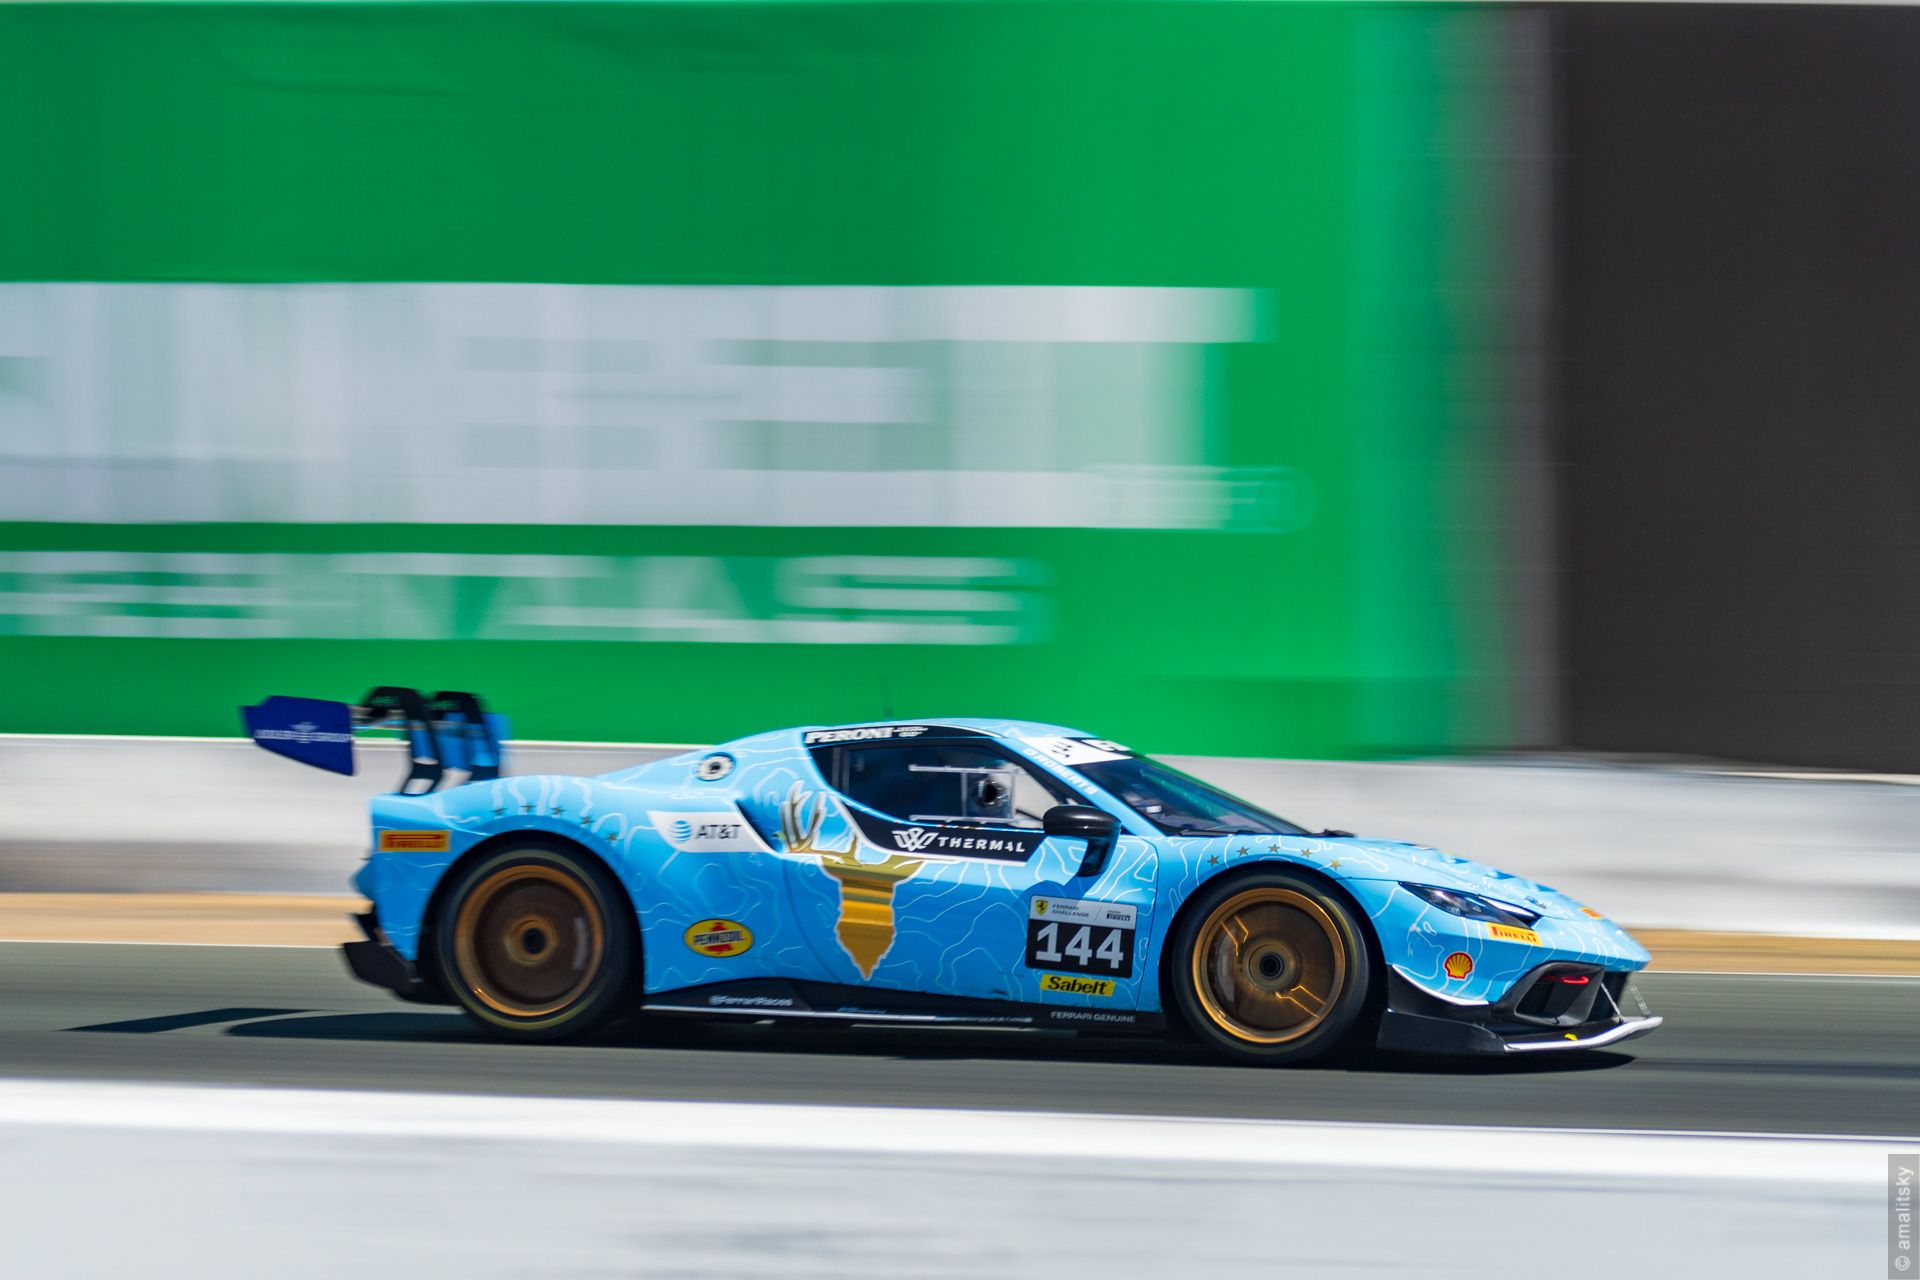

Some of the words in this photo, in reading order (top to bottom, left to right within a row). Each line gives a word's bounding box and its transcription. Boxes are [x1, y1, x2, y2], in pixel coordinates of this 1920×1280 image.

[805, 727, 895, 744] PERONI
[695, 823, 741, 839] AT&T
[938, 836, 1025, 853] THERMAL
[1051, 909, 1090, 918] CHALLENGE
[1491, 926, 1537, 942] PIRELLI
[1035, 922, 1124, 969] 144
[1047, 975, 1107, 995] Sabelt
[1050, 1011, 1092, 1020] FERRARI
